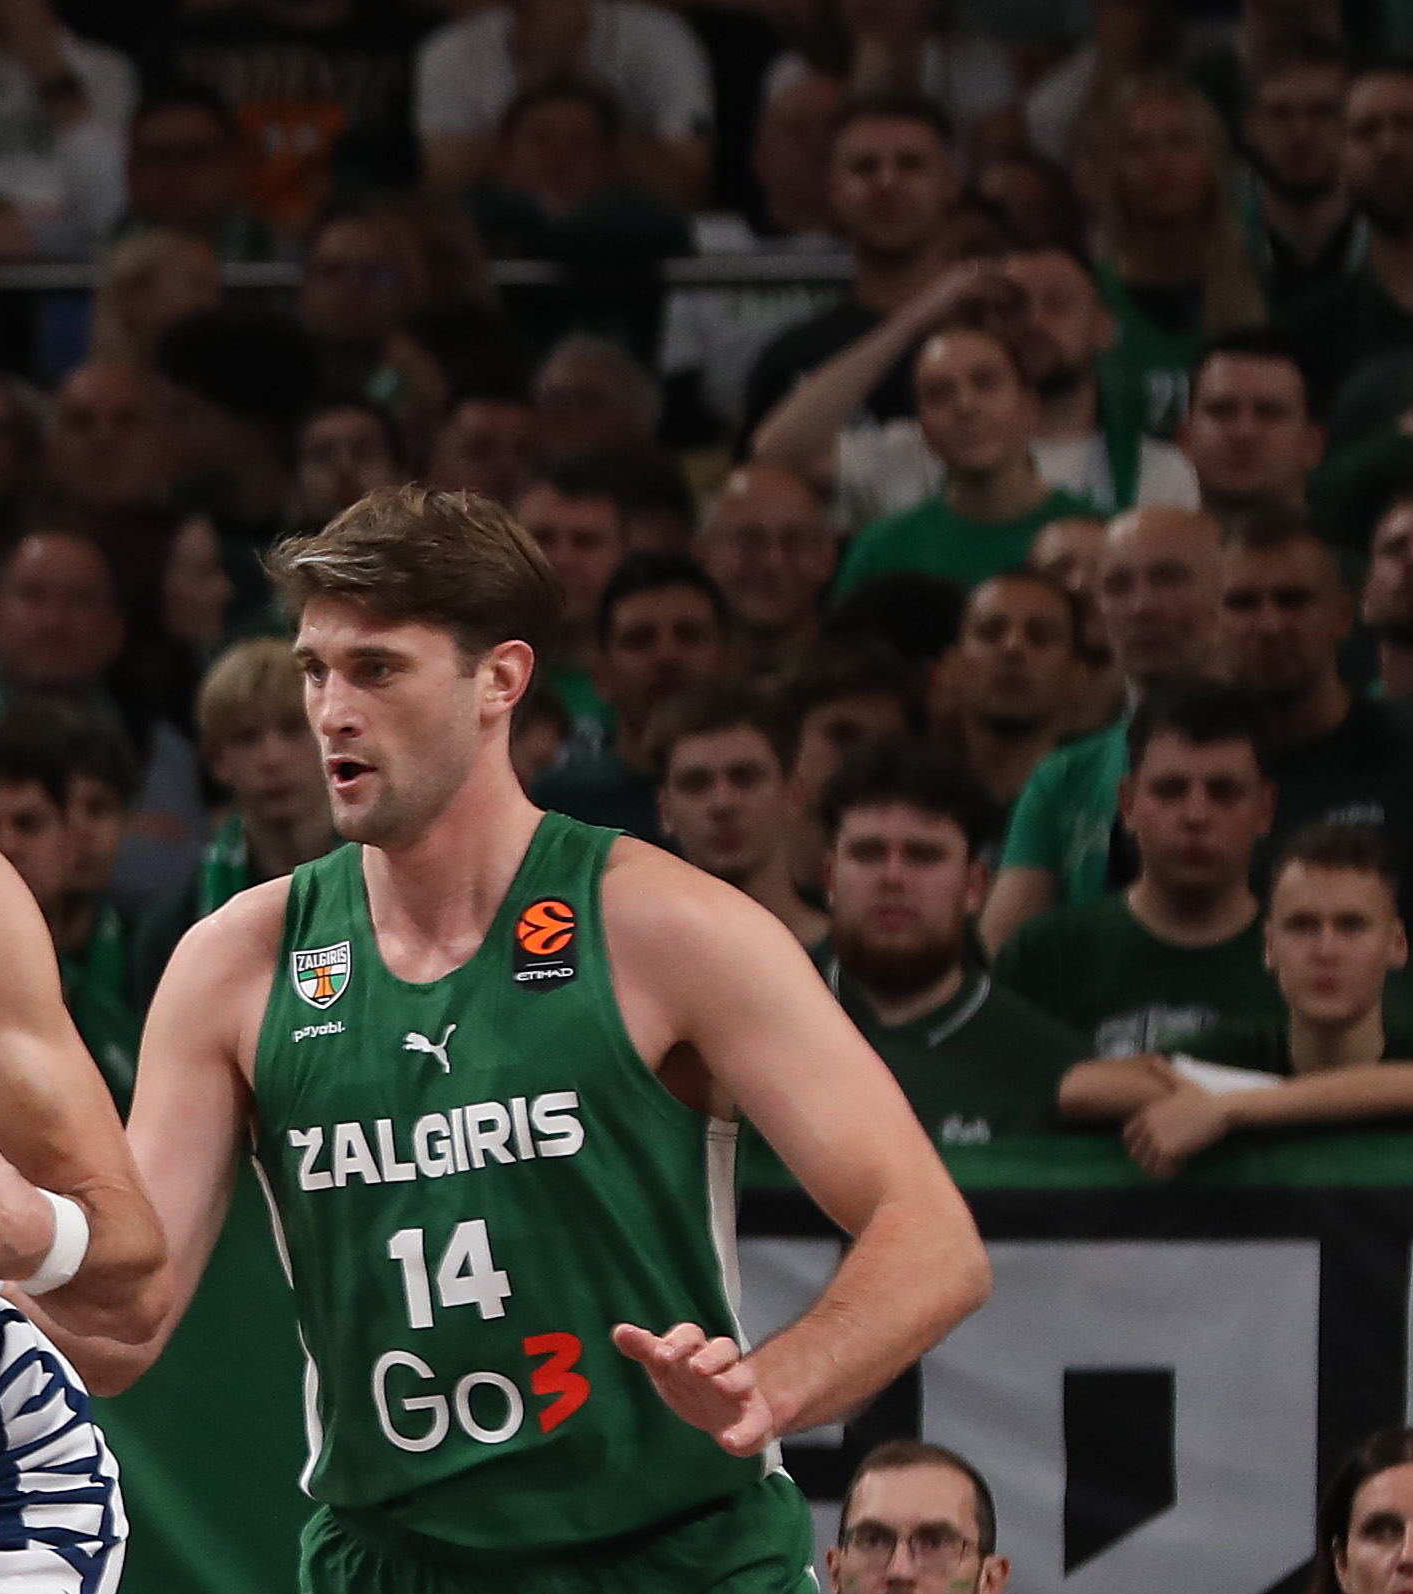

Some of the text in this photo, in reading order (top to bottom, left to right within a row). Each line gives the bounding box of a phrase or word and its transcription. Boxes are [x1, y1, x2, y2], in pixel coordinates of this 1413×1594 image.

[516, 967, 574, 981] ETIHAD
[388, 1218, 512, 1330] 14
[373, 1332, 591, 1453] Go3
